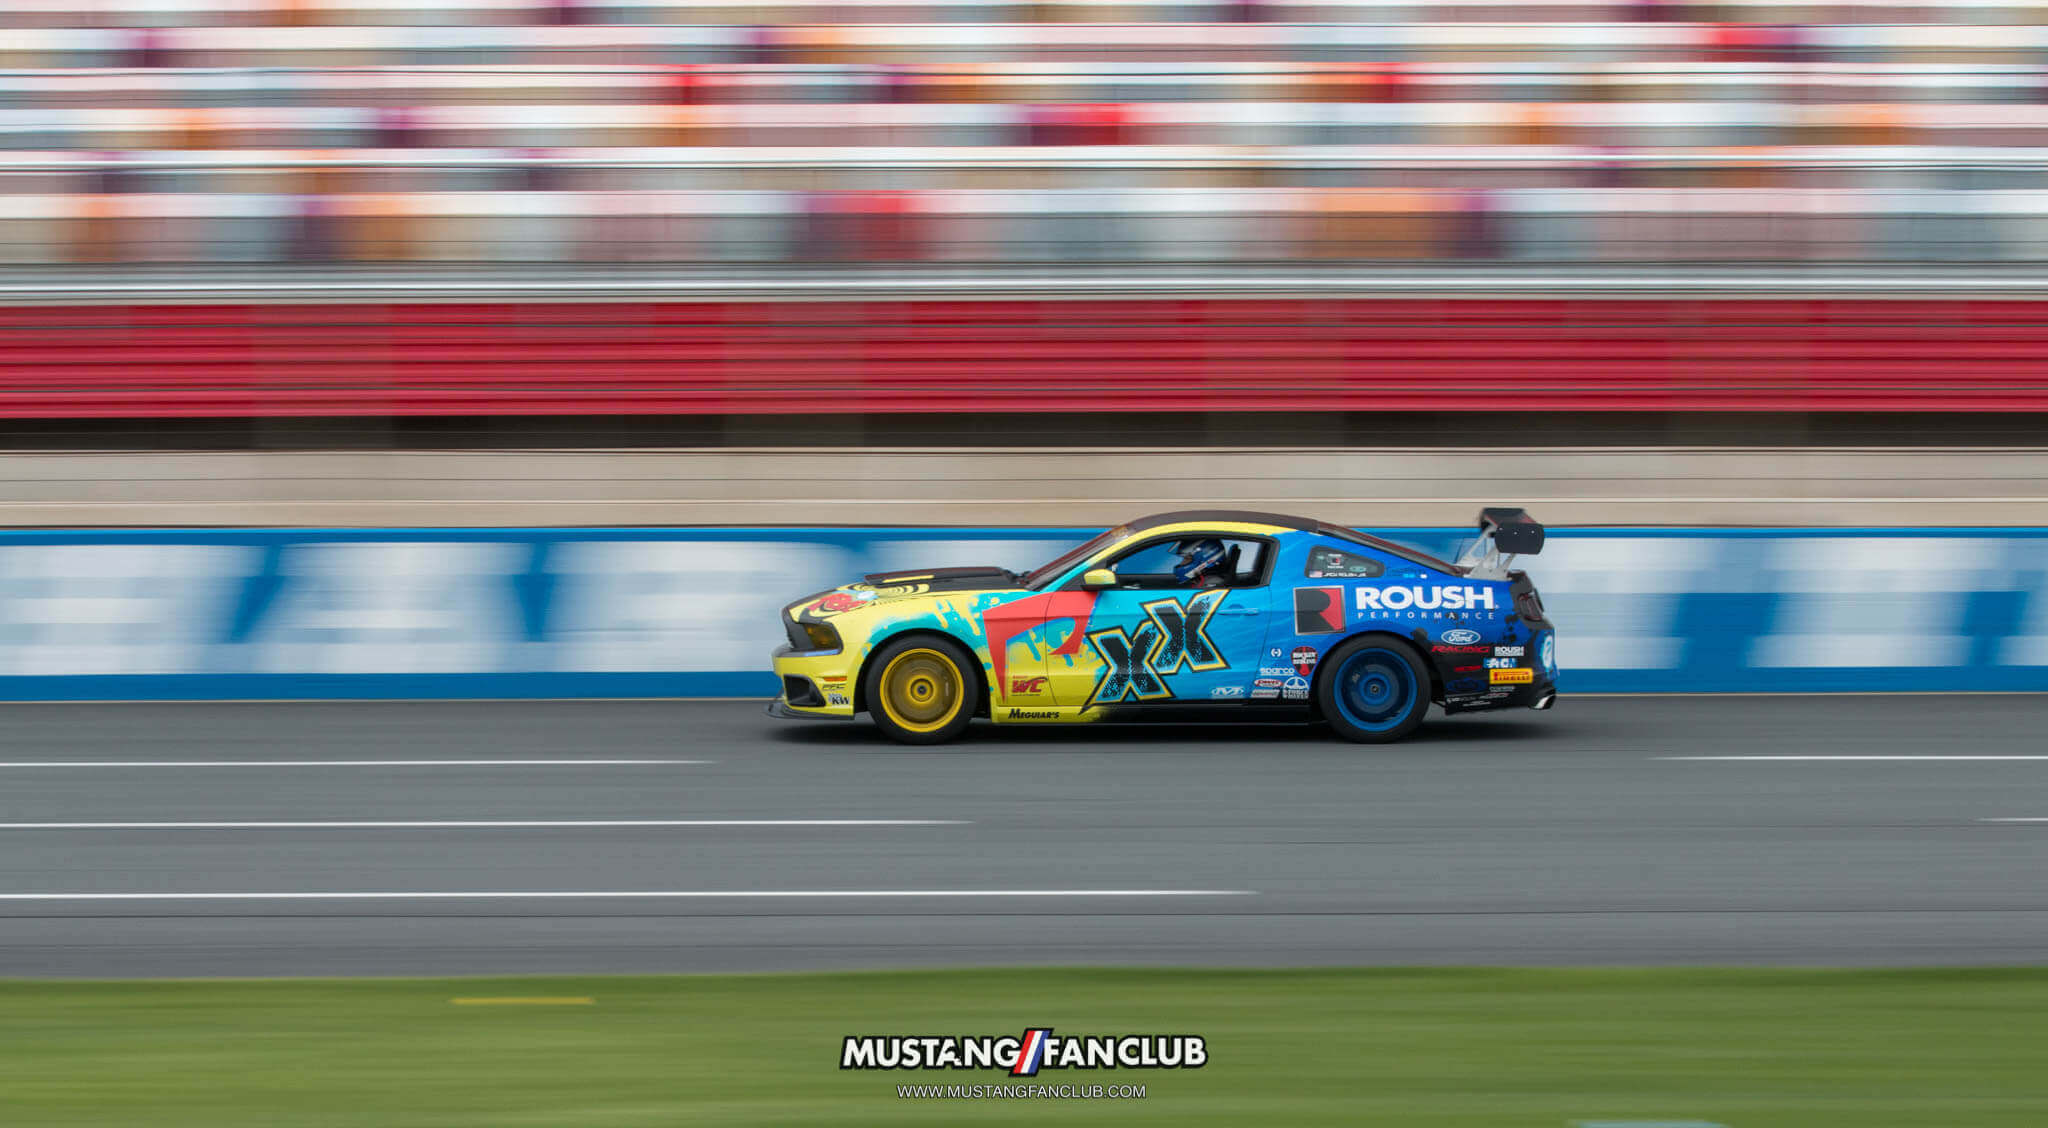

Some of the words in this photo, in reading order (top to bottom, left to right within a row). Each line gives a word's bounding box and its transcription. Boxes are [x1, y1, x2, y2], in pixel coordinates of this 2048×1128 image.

[1355, 586, 1493, 610] ROUSH
[1358, 612, 1494, 620] PERFORMANCE
[1448, 631, 1474, 643] Ford
[1431, 645, 1490, 654] RACING
